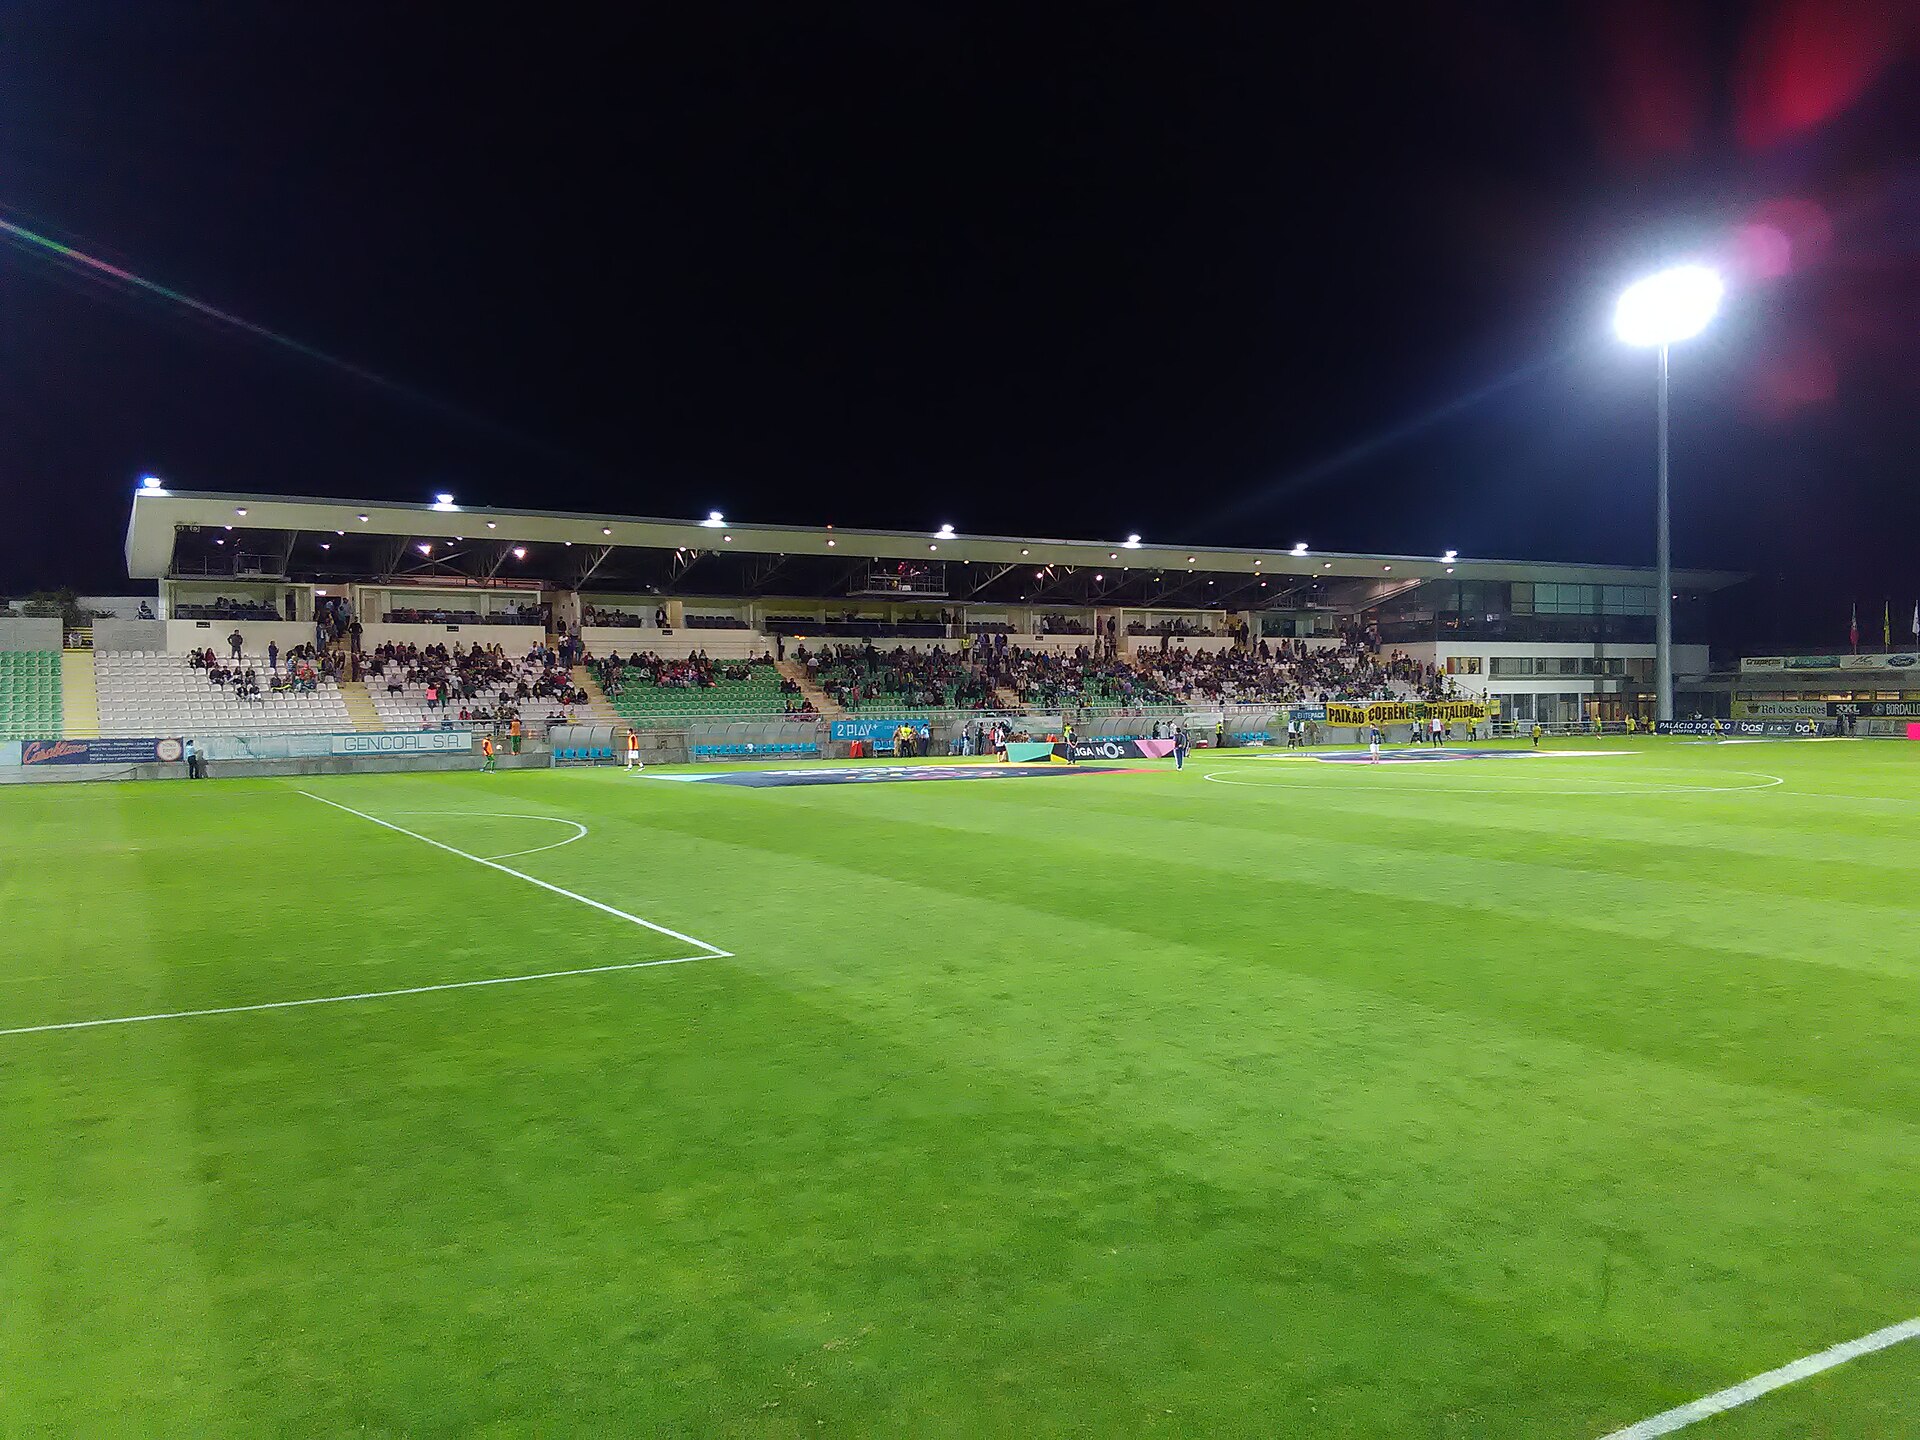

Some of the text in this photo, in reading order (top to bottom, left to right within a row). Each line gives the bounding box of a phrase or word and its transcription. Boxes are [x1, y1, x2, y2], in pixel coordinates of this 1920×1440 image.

[1761, 704, 1776, 714] Rei
[1778, 704, 1793, 714] dos
[1836, 703, 1860, 713] 3XL
[1659, 721, 1693, 729] PALÁCIO
[1741, 722, 1765, 732] basi
[1795, 722, 1820, 733] bai
[344, 734, 461, 751] GENCOAL S.A.
